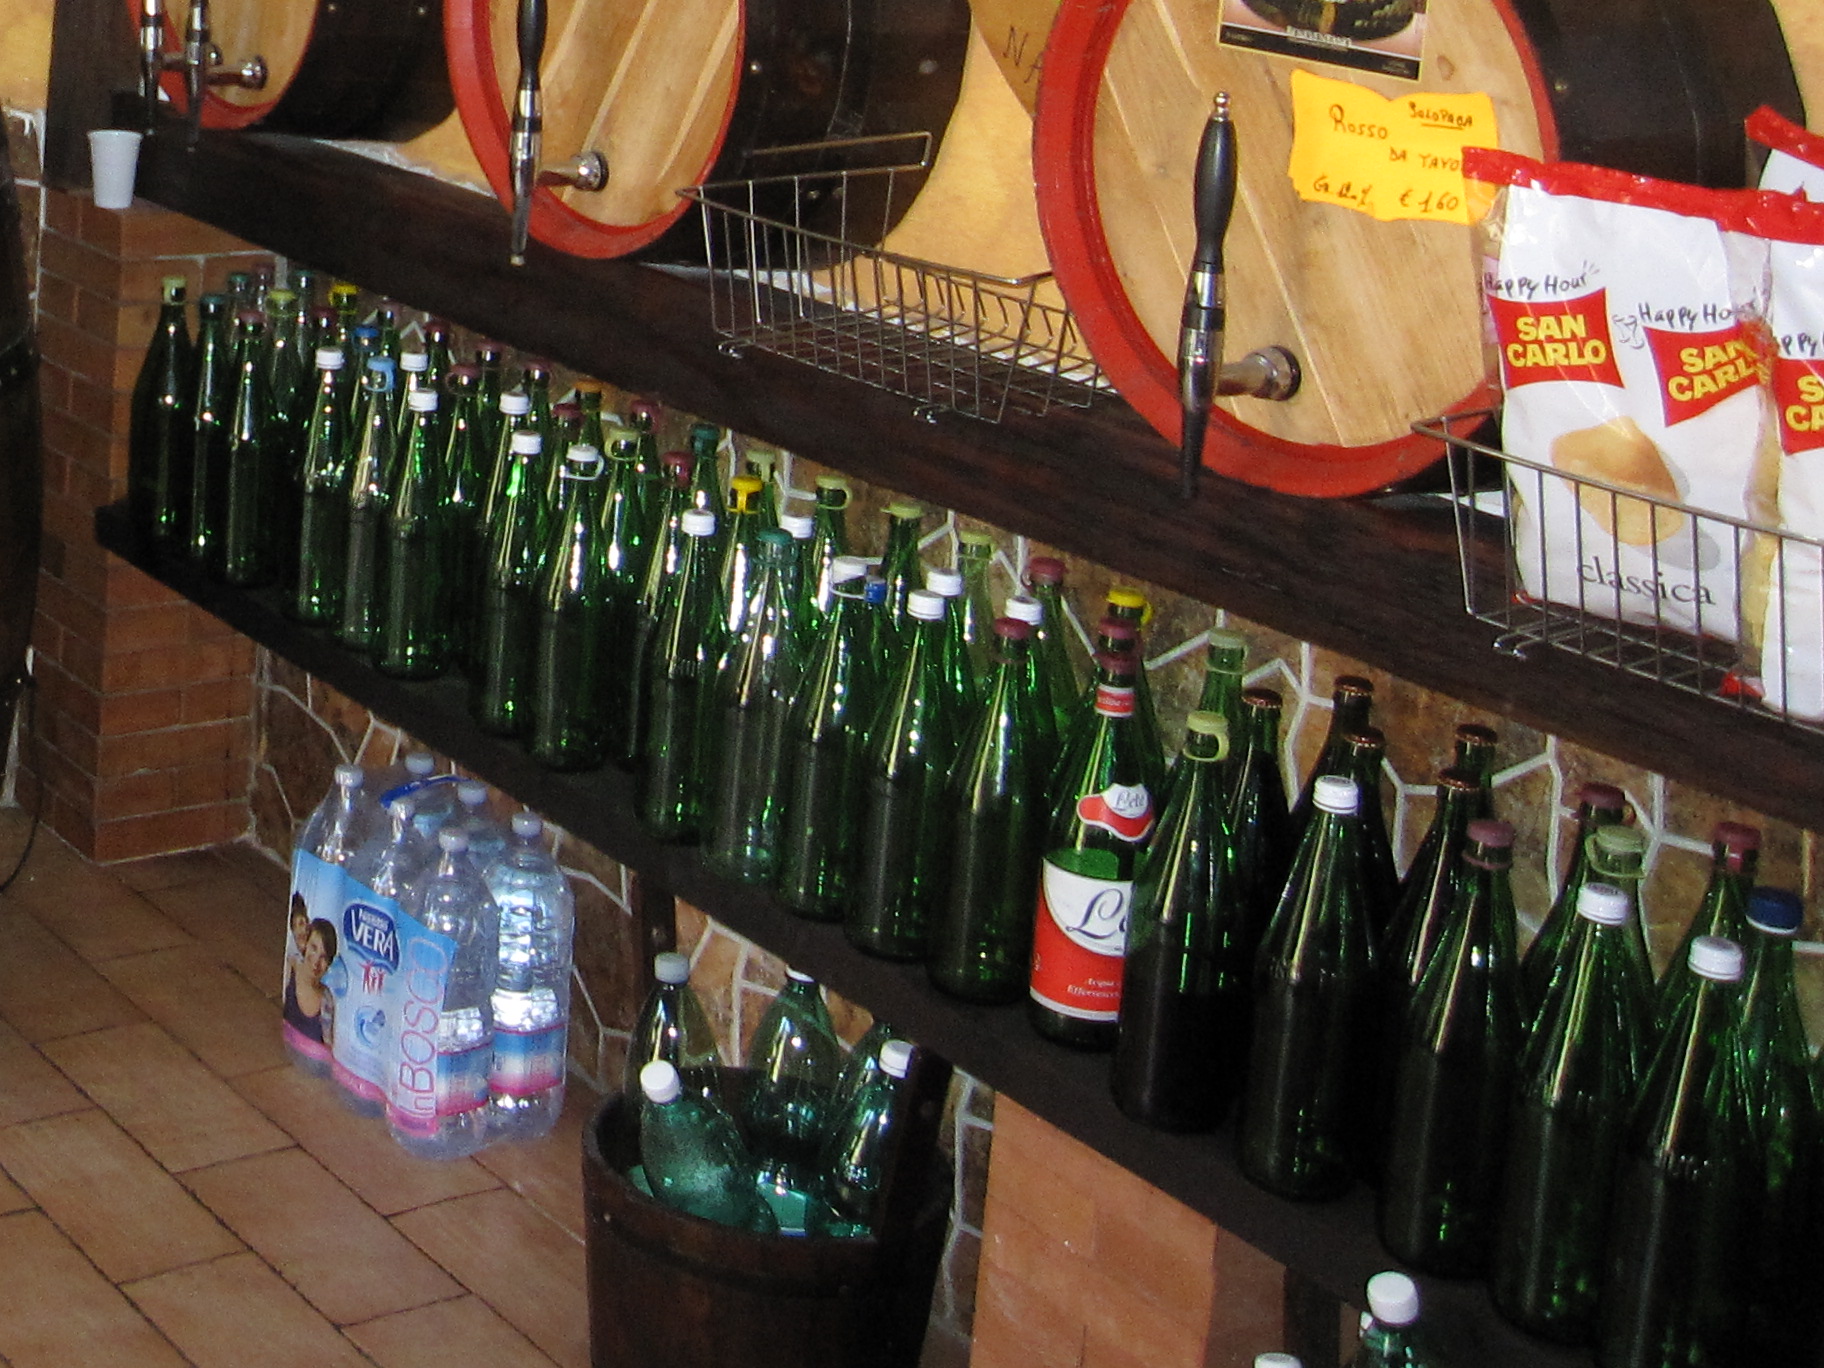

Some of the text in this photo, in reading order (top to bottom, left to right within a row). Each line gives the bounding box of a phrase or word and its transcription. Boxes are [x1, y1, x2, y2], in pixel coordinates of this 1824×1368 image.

[1418, 153, 1461, 172] TAVO
[1483, 271, 1588, 300] Happy Hour
[1515, 314, 1587, 342] SAN
[1638, 301, 1699, 330] Happy
[1506, 338, 1607, 368] CARLO
[1781, 332, 1819, 357] ppy
[1576, 555, 1717, 606] classica
[350, 908, 394, 962] VERA
